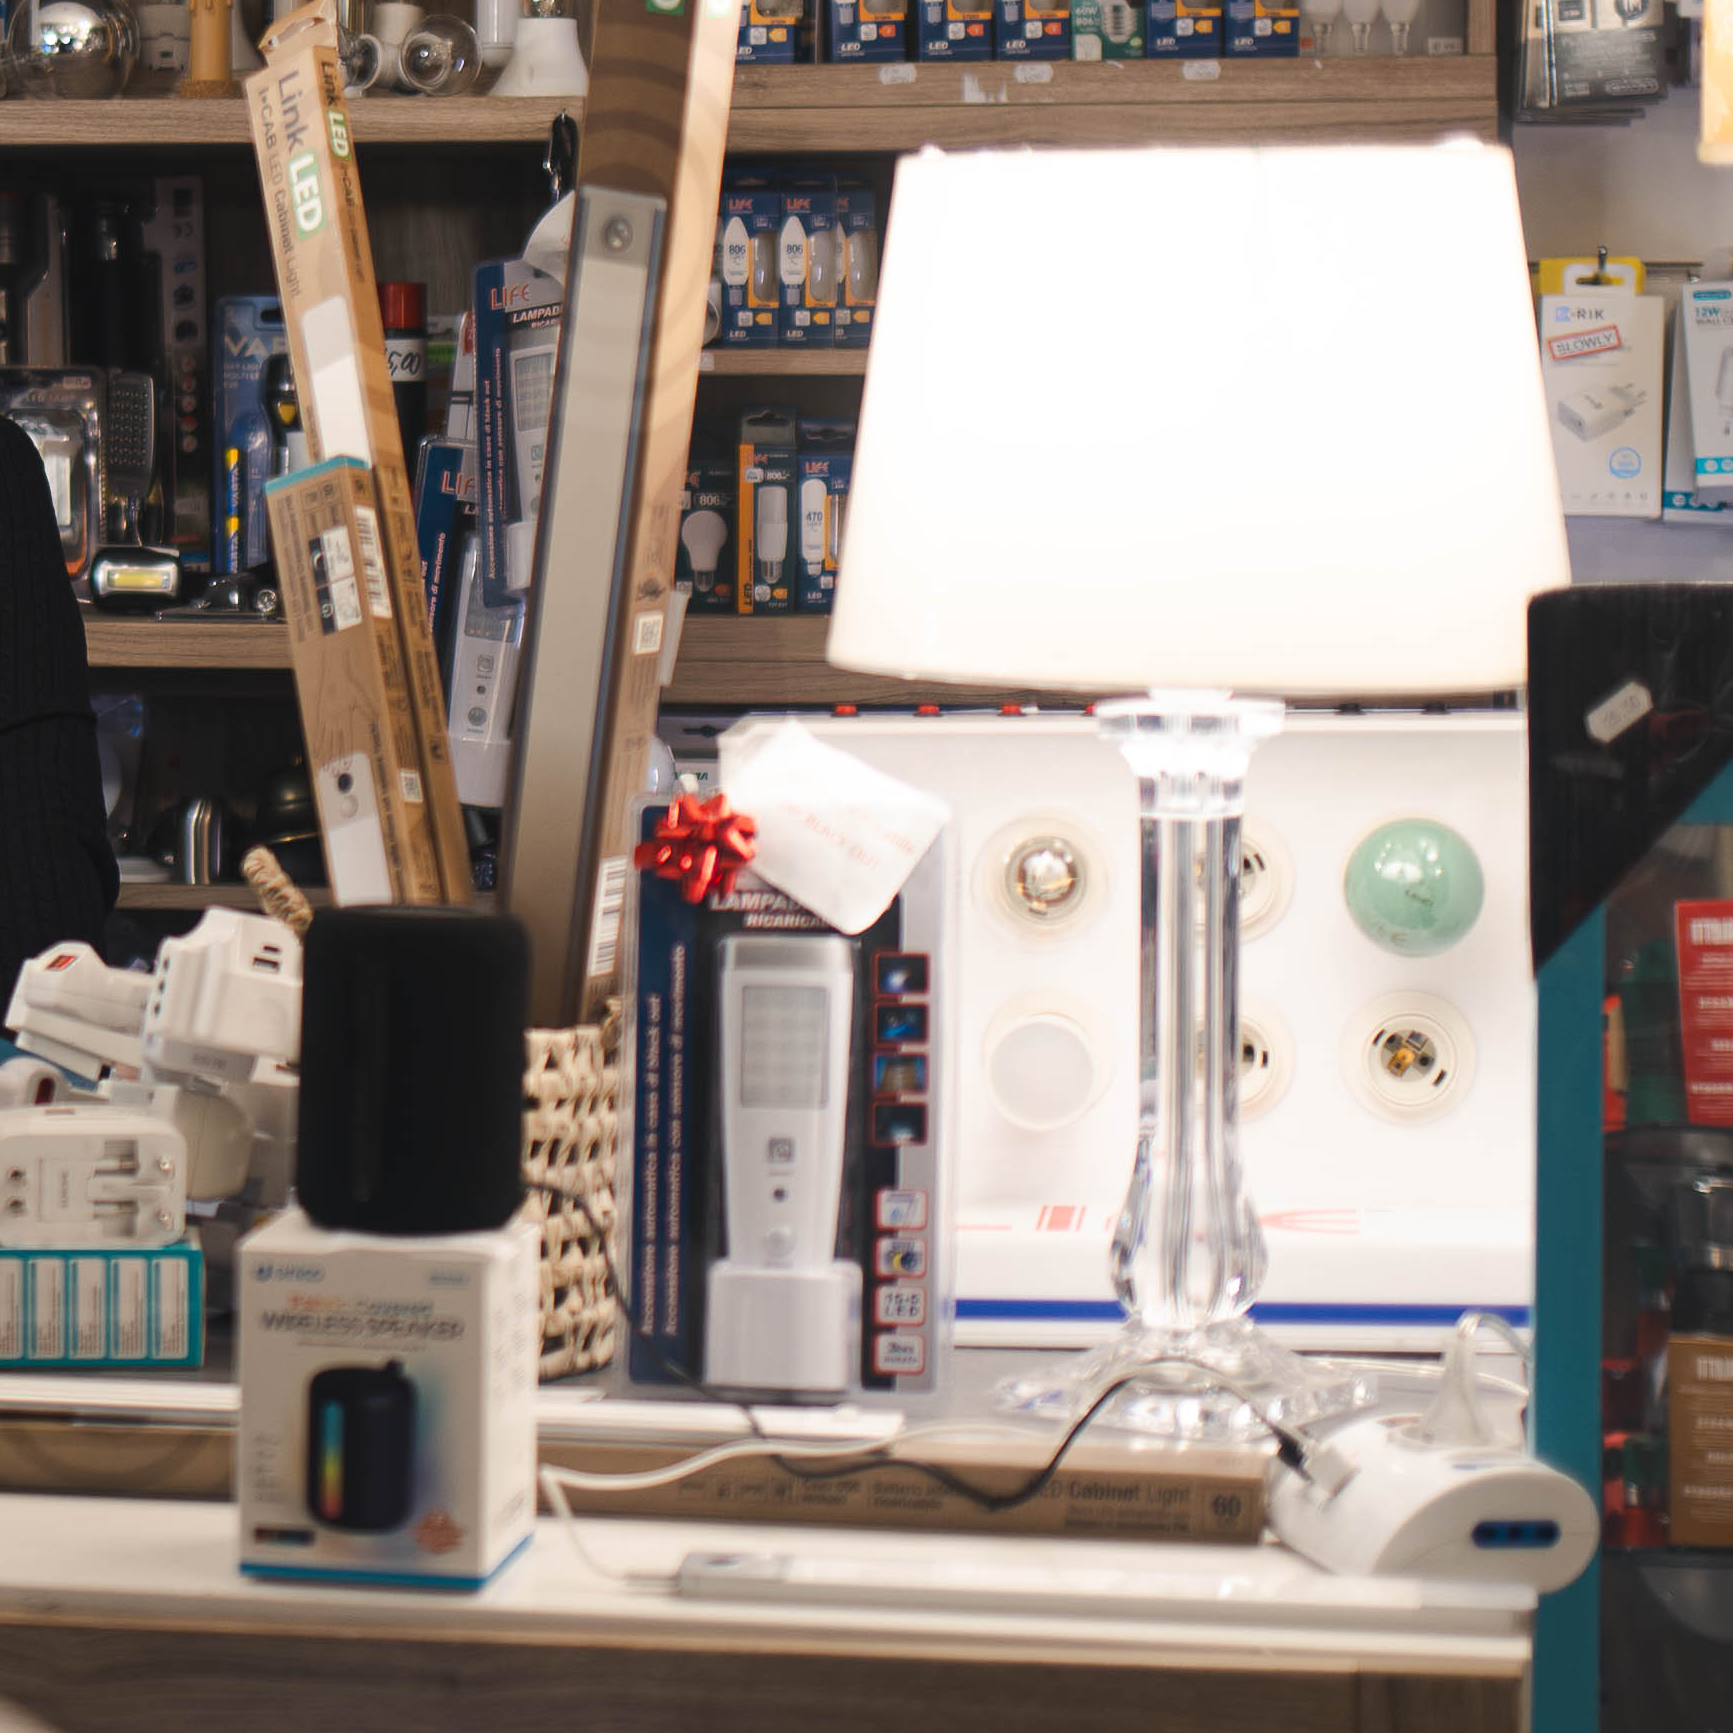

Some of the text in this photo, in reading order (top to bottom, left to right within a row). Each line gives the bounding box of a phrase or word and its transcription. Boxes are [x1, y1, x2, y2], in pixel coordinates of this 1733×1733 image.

[842, 42, 860, 52] LED
[930, 41, 949, 51] LED
[321, 60, 336, 106] Link
[278, 69, 308, 154] Link
[328, 112, 349, 157] LED
[289, 154, 322, 234] LED
[729, 197, 754, 211] LIFE
[787, 197, 811, 211] LIFE
[274, 189, 295, 256] Cabinet
[729, 244, 746, 255] 806
[787, 244, 804, 255] 806
[491, 283, 530, 310] LIFE
[512, 304, 564, 323] LAMPAD
[805, 461, 829, 475] LIFE
[806, 511, 823, 522] 470
